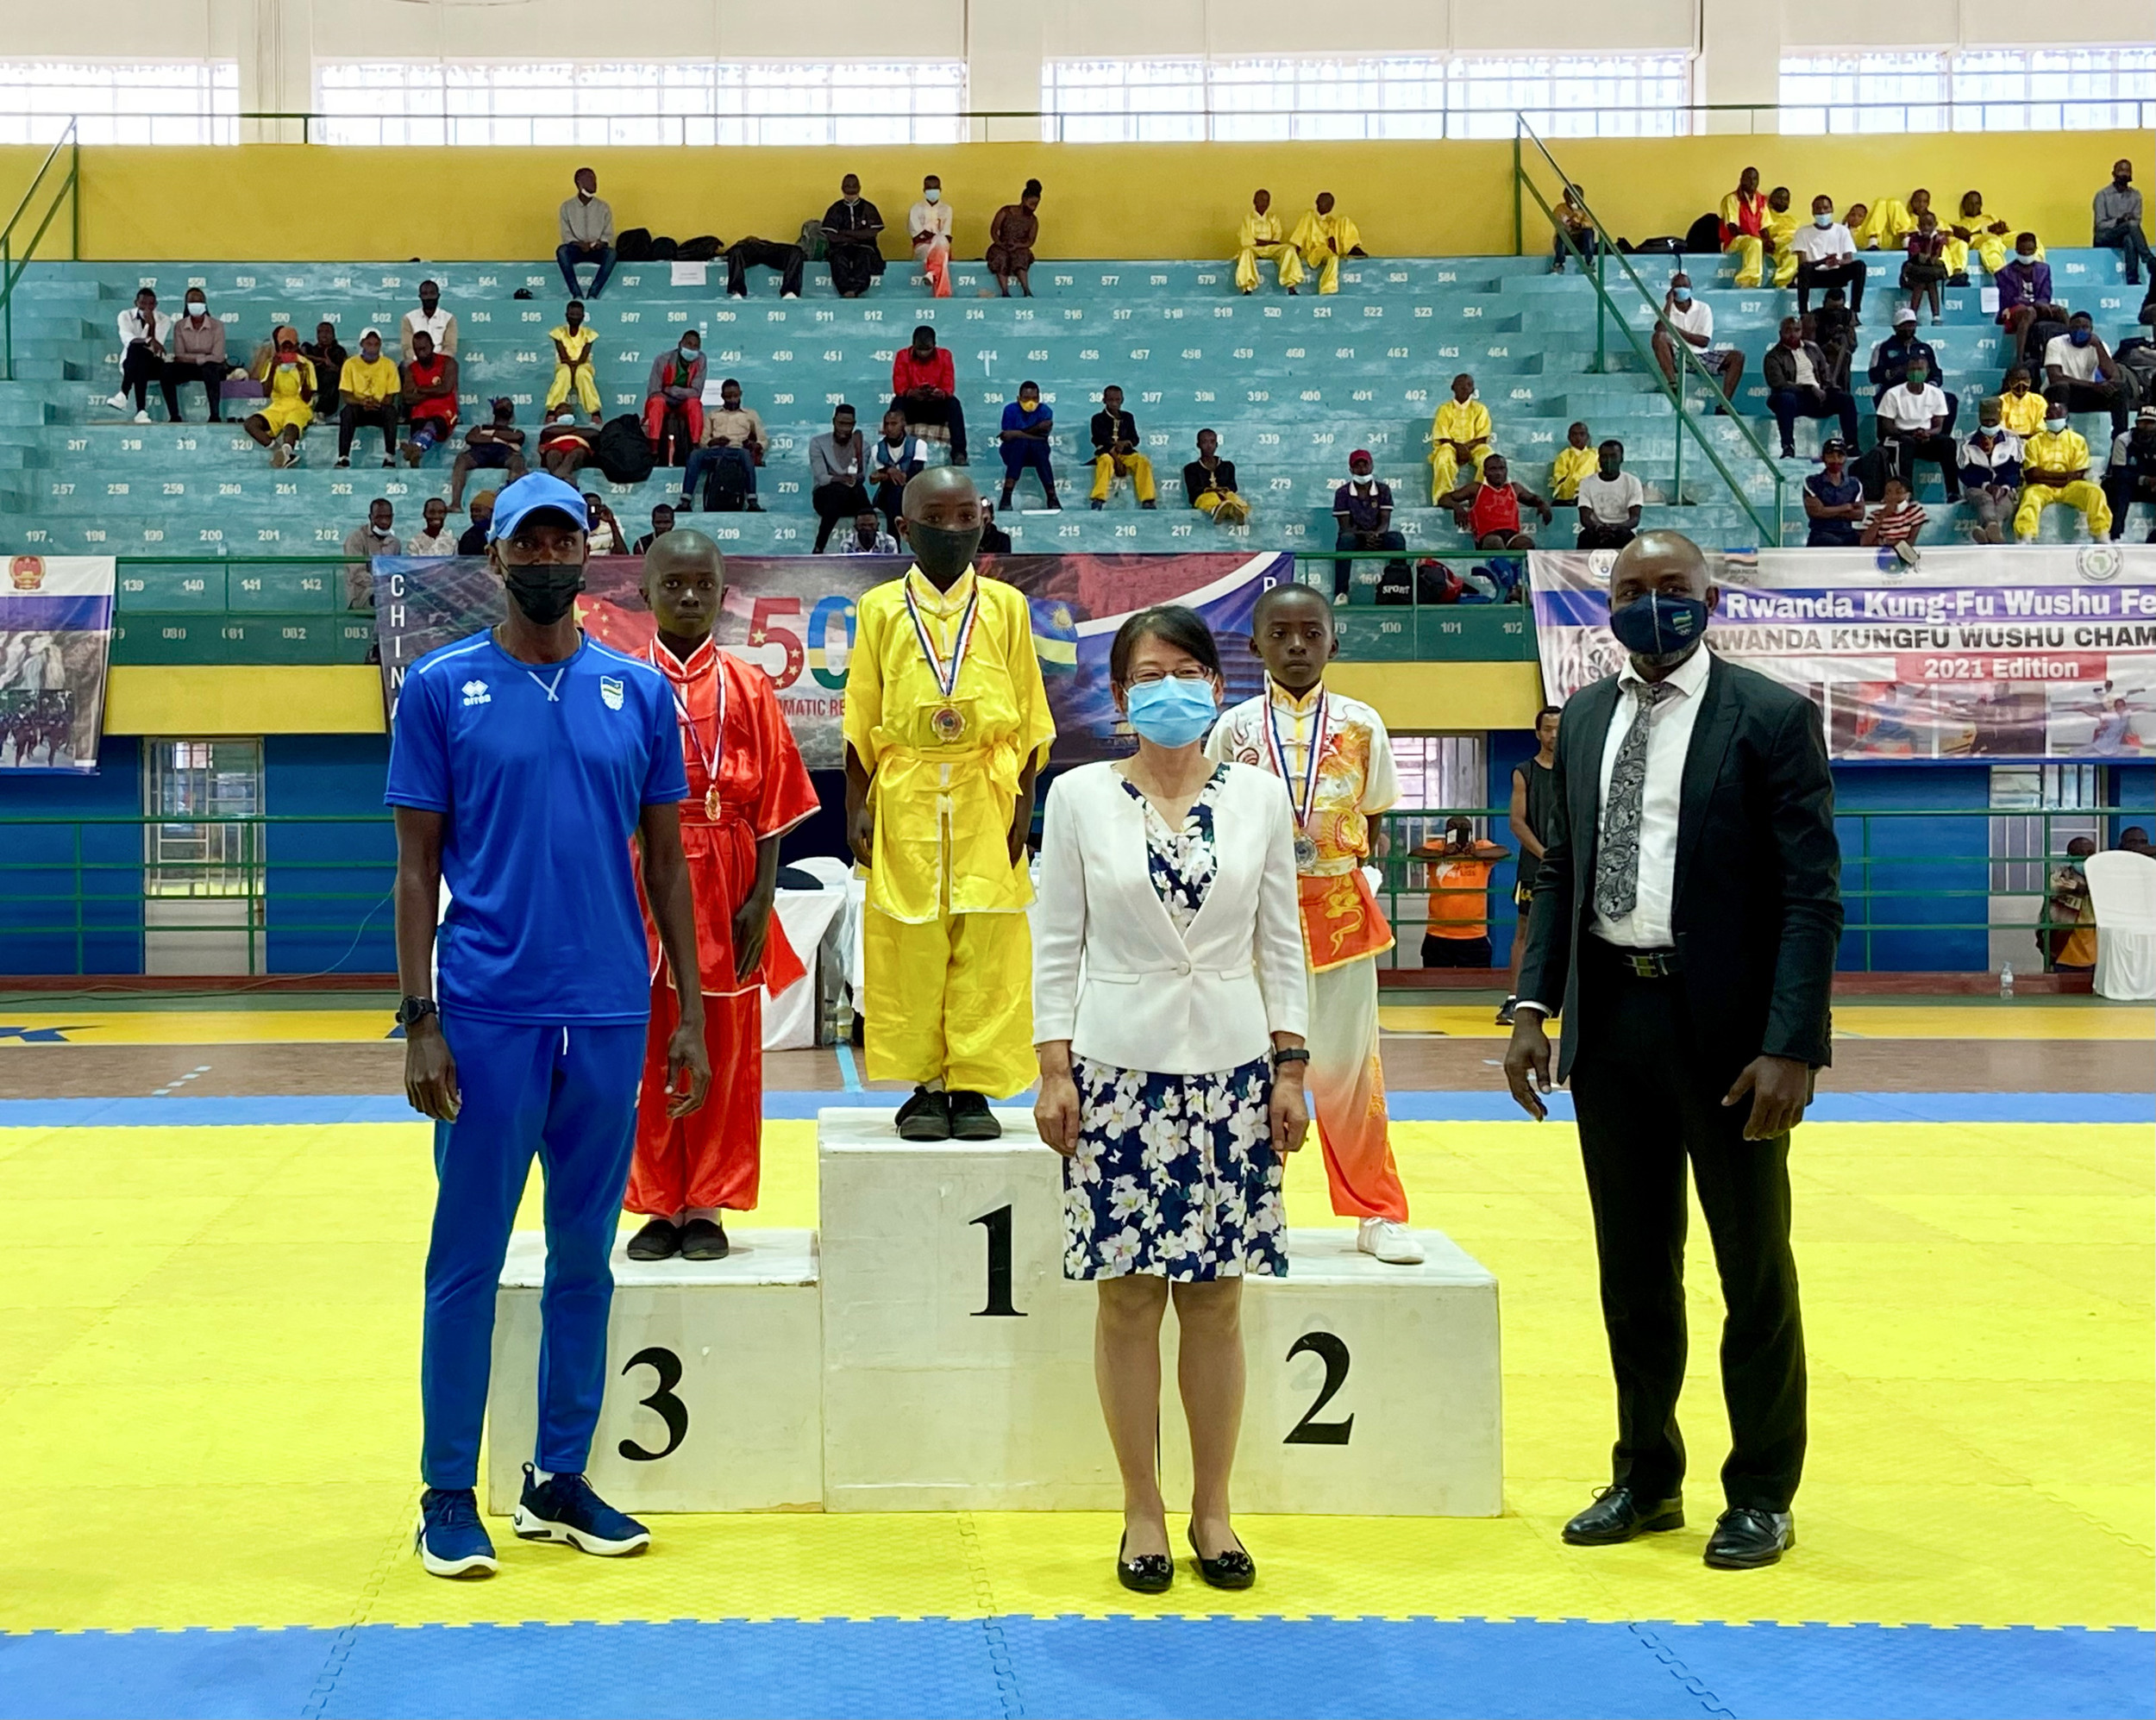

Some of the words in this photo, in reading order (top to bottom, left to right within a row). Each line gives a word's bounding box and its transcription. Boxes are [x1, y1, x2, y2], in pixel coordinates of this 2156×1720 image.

[623, 277, 641, 286] 567
[958, 277, 975, 285] 574
[1055, 276, 1073, 285] 576
[1101, 276, 1119, 285] 577
[2101, 298, 2121, 308] 534
[816, 311, 834, 321] 511
[864, 311, 883, 320] 512
[915, 310, 934, 319] 513
[966, 310, 984, 319] 514
[1015, 310, 1034, 319] 515
[1113, 310, 1131, 319] 517
[1263, 308, 1282, 317] 520
[1313, 308, 1332, 317] 521
[1363, 307, 1383, 316] 522
[1414, 307, 1432, 316] 523
[1463, 307, 1482, 316] 524
[323, 313, 341, 322] 501
[372, 313, 392, 322] 502
[471, 312, 491, 322] 504
[522, 312, 542, 322] 505
[621, 313, 640, 322] 507
[619, 352, 639, 361] 447
[773, 351, 793, 360] 450
[824, 351, 843, 360] 451
[874, 351, 893, 360] 452
[1028, 350, 1048, 360] 455
[1080, 350, 1099, 360] 456
[1130, 349, 1150, 359] 457
[1336, 348, 1354, 358] 461
[1387, 347, 1408, 357] 462
[1438, 347, 1458, 357] 463
[1488, 347, 1508, 356] 464
[774, 394, 793, 403] 390
[826, 394, 844, 403] 391
[984, 393, 1003, 403] 394
[1142, 392, 1162, 402] 397
[1247, 391, 1268, 401] 399
[1300, 391, 1320, 400] 400
[1352, 391, 1372, 400] 401
[1405, 390, 1426, 400] 402
[1511, 389, 1531, 398] 404
[88, 396, 107, 405] 377
[1149, 435, 1169, 445] 337
[1258, 434, 1279, 444] 339
[1313, 434, 1333, 443] 340
[1368, 433, 1388, 443] 341
[1531, 433, 1552, 442] 344
[67, 440, 86, 450] 317
[177, 440, 196, 450] 319
[231, 440, 253, 450] 320
[772, 439, 793, 448] 330
[386, 484, 408, 493] 263
[778, 483, 799, 492] 270
[1161, 479, 1181, 490] 277
[1270, 478, 1292, 489] 279
[52, 484, 75, 494] 257
[108, 484, 129, 494] 258
[163, 484, 184, 494] 259
[219, 484, 241, 494] 260
[276, 484, 297, 494] 261
[331, 484, 353, 494] 262
[1059, 526, 1080, 536] 215
[1115, 525, 1136, 536] 216
[1171, 526, 1192, 536] 217
[1401, 522, 1421, 534] 221
[26, 530, 47, 541] 197
[199, 529, 222, 541] 200
[258, 529, 279, 541] 201
[315, 529, 339, 541] 202
[718, 529, 739, 539] 209
[774, 529, 795, 539] 210
[123, 579, 144, 591] 139
[183, 579, 204, 591] 140
[241, 579, 260, 591] 141
[302, 579, 322, 590] 142
[1382, 585, 1410, 595] SPORT
[1727, 591, 1854, 618] Rwanda
[1864, 590, 1993, 624] Kung-Fu
[2002, 588, 2109, 616] Wushu
[1380, 622, 1401, 633] 100
[1440, 622, 1461, 633] 101
[1502, 622, 1522, 633] 102
[1705, 629, 1822, 650] RWANDA
[1831, 629, 1950, 648] KUNGFU
[1959, 628, 2065, 647] WUSHU
[2074, 627, 2156, 647] CHAM
[1924, 659, 1984, 679] 2021
[1992, 657, 2079, 679] Edition
[969, 1204, 1028, 1317] 1
[1282, 1331, 1355, 1445] 2
[617, 1346, 688, 1461] 3
